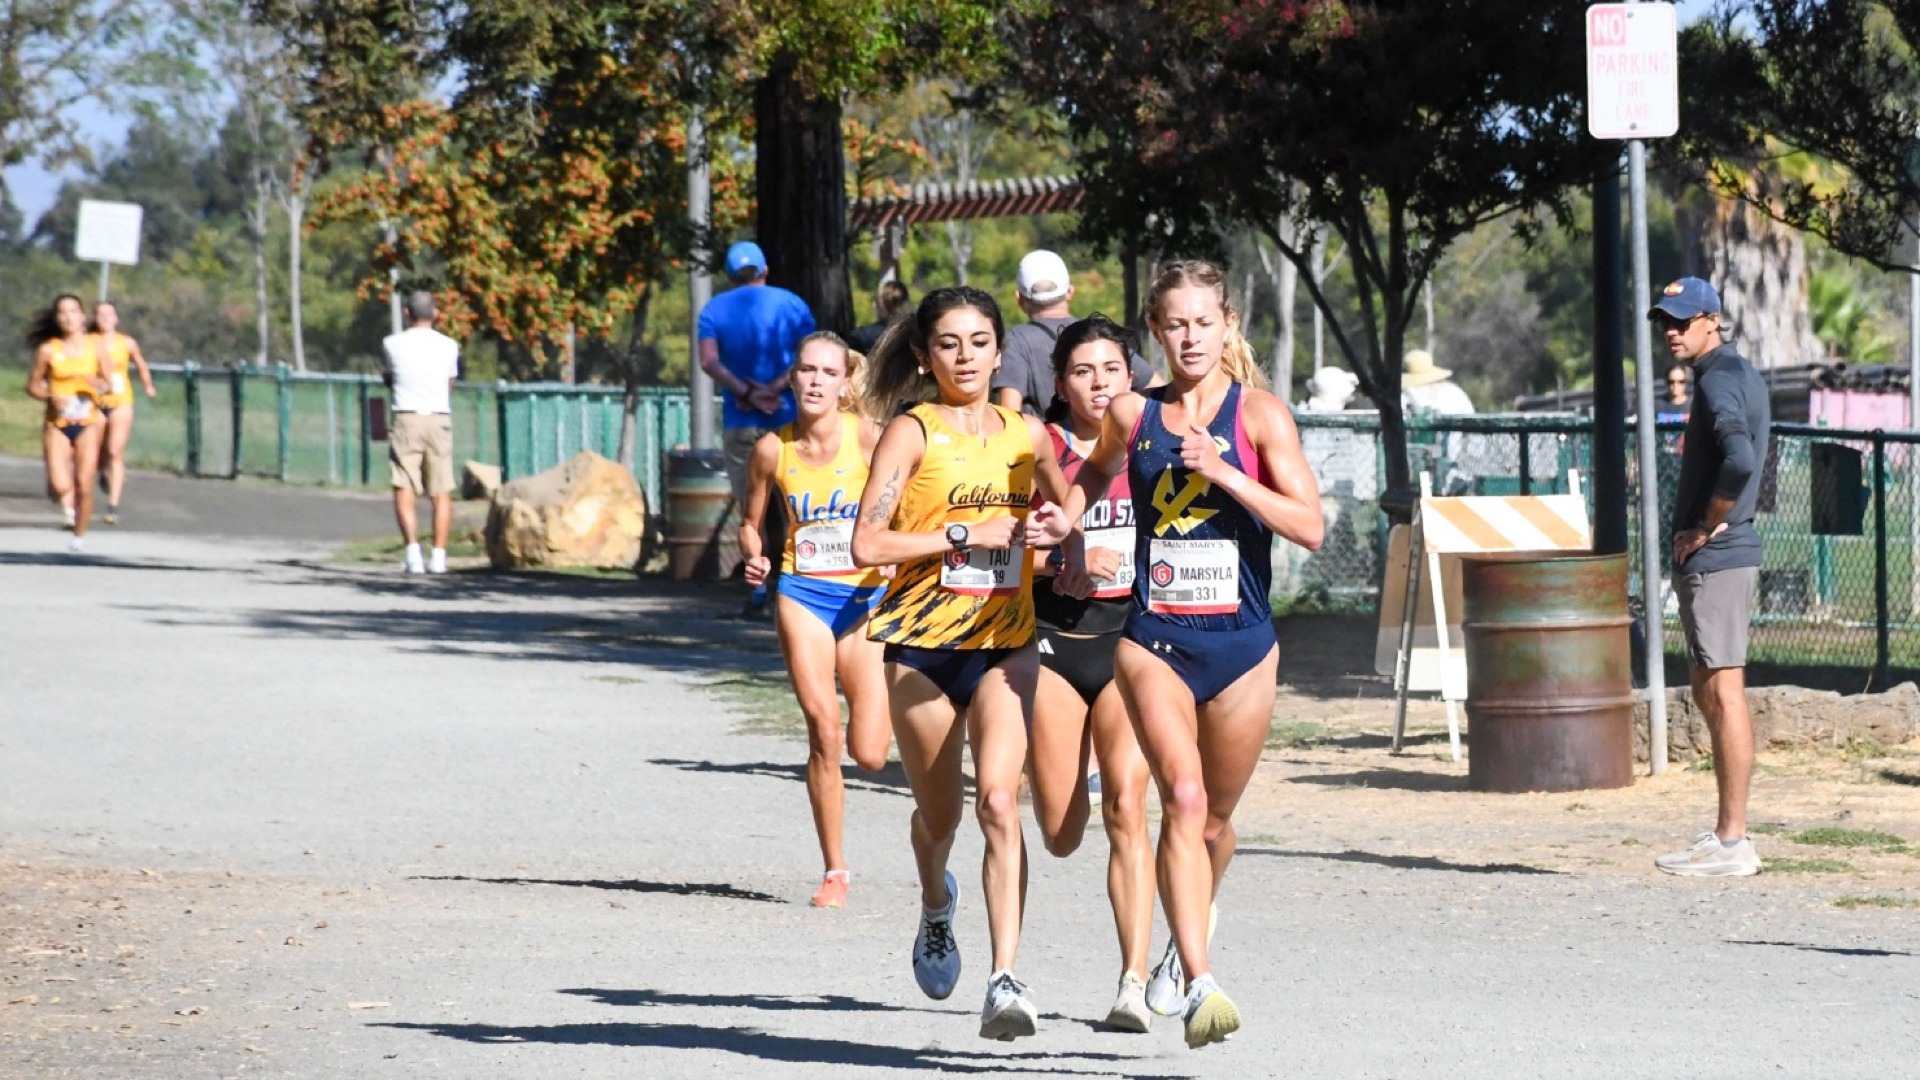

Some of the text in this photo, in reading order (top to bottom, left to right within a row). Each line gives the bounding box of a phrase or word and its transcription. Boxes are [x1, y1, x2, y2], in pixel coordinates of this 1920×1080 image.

[1594, 12, 1624, 43] NO
[1596, 52, 1671, 75] PARKING
[1618, 80, 1647, 97] FIRE
[1615, 103, 1650, 121] LANE
[948, 483, 1029, 513] California
[1162, 540, 1224, 549] SAINT MARY'S
[988, 548, 1011, 566] TAU
[1180, 566, 1233, 580] MARSYLA
[1195, 587, 1217, 601] 331
